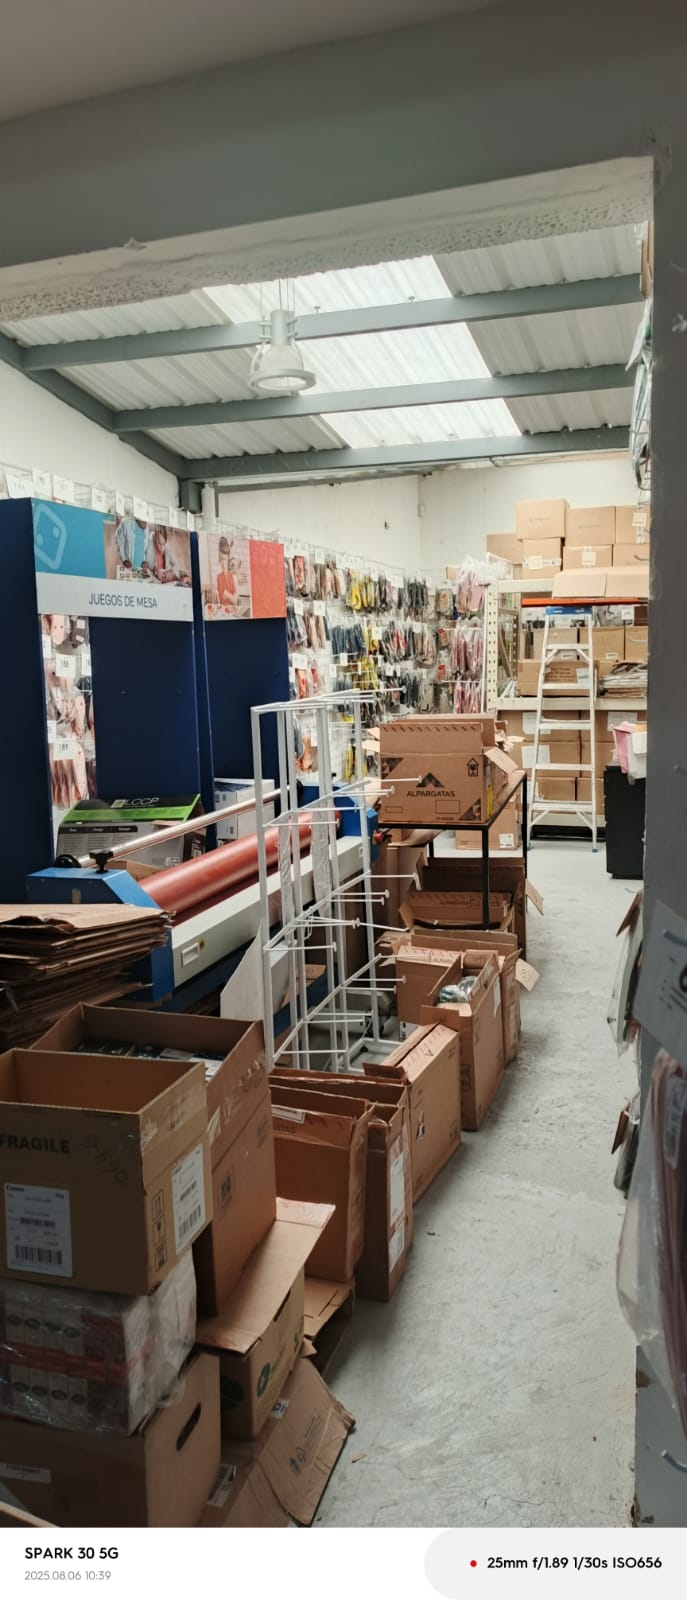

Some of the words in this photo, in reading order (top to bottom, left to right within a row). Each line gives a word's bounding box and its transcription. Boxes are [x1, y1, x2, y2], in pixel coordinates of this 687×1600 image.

[88, 593, 122, 607] JUEGOS
[124, 596, 135, 607] DE
[136, 597, 158, 609] MESA
[406, 790, 455, 798] ALPARGATAS
[0, 1134, 70, 1154] FRAGILE
